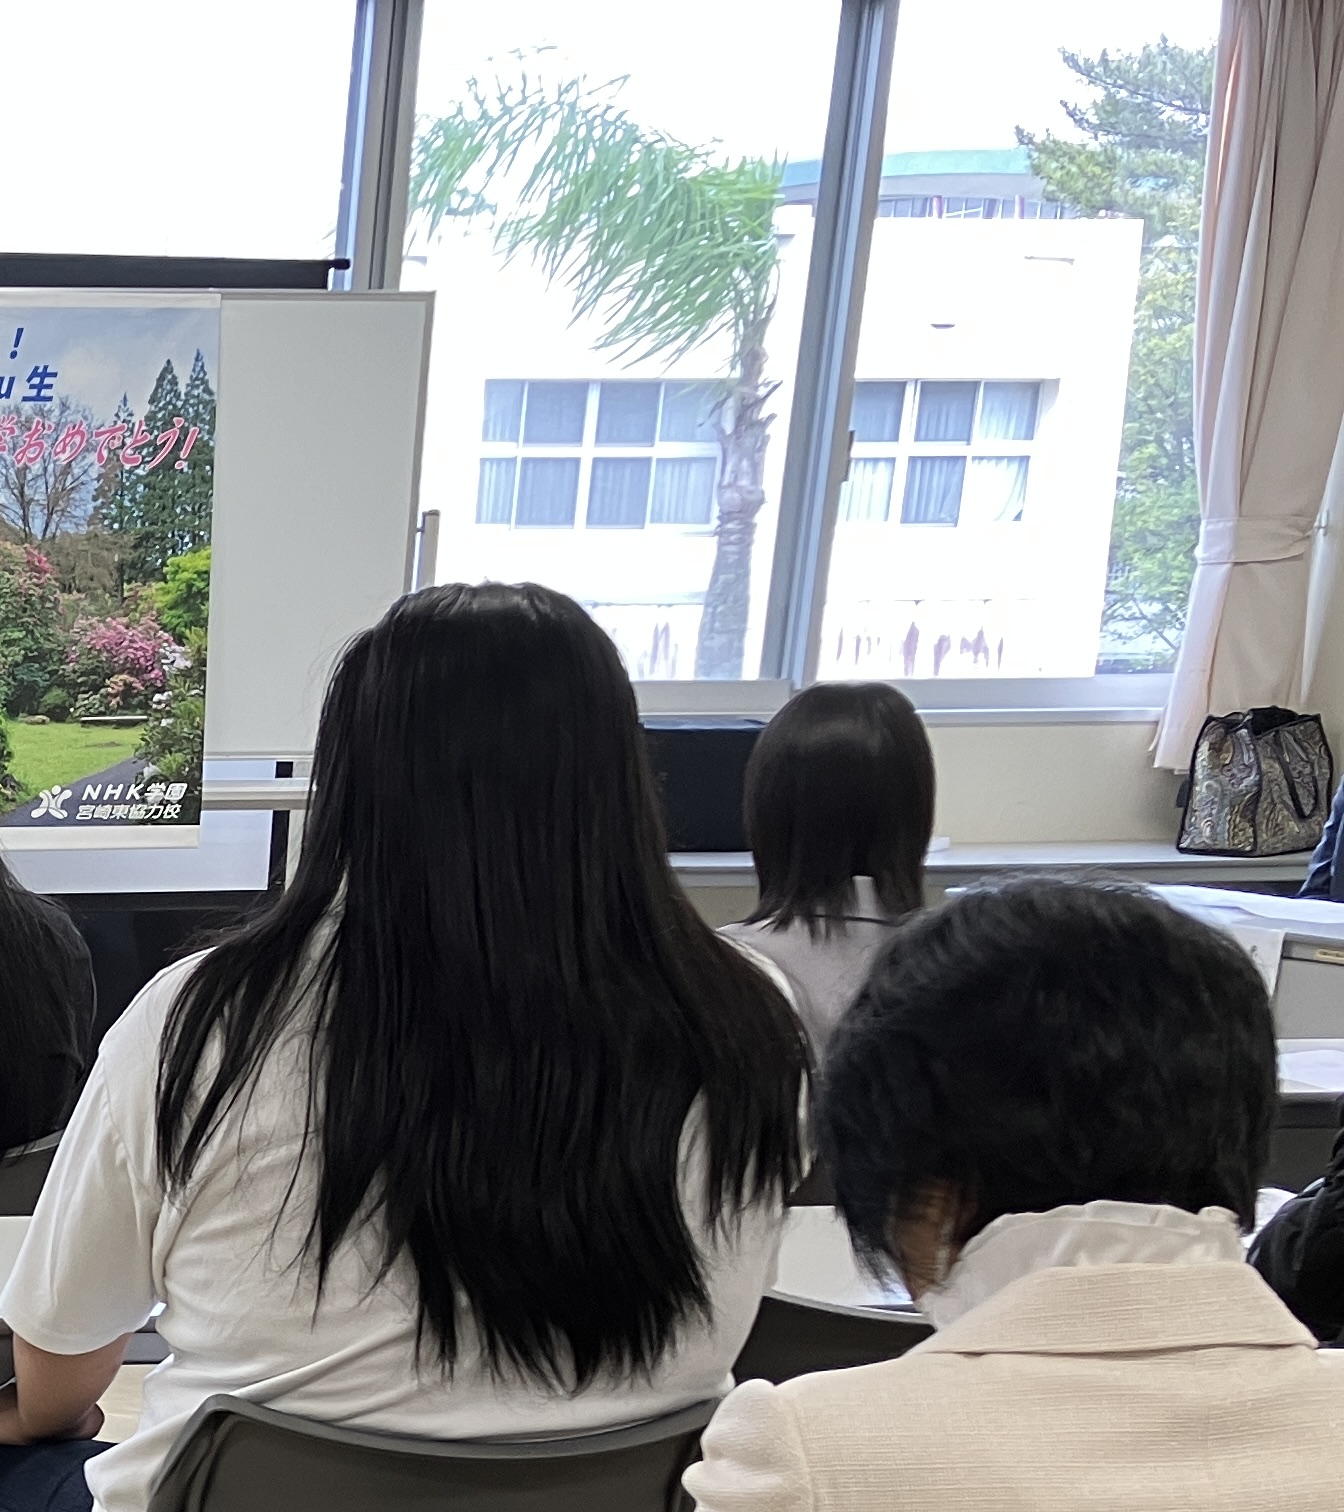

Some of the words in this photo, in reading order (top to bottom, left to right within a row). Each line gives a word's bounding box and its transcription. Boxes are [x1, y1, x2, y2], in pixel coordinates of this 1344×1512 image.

[20, 364, 59, 403] 生
[81, 783, 188, 803] NHK学園
[75, 804, 182, 820] 宮崎東協力校
